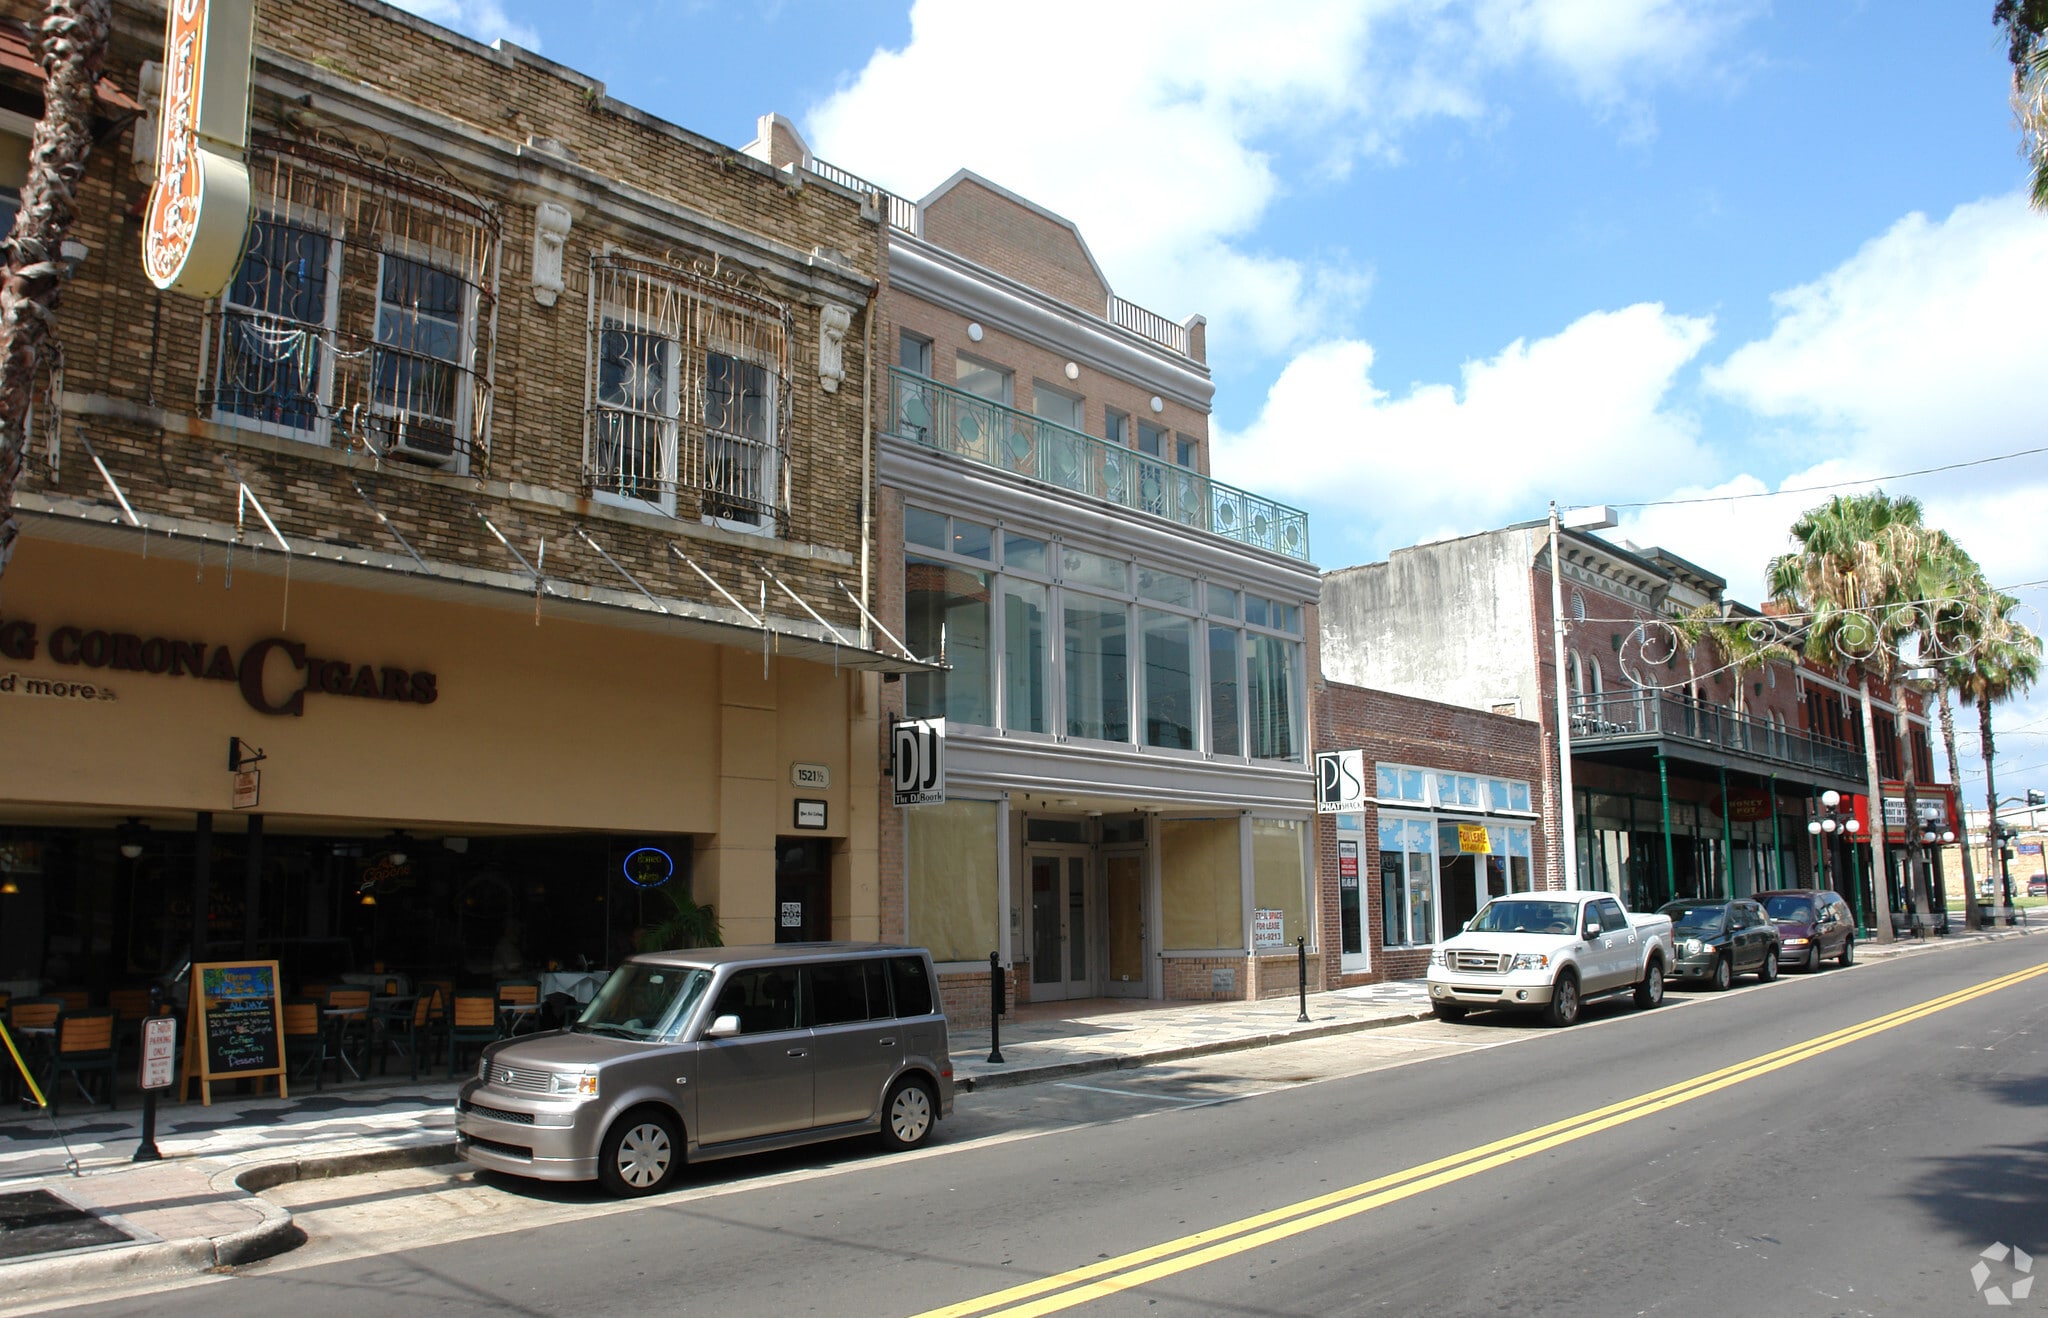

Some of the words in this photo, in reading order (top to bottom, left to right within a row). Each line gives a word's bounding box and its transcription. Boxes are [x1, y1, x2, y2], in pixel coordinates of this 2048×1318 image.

[50, 626, 238, 682] CORONA
[239, 638, 438, 717] CIGARS
[896, 727, 938, 792] DJ
[1320, 756, 1361, 802] PS
